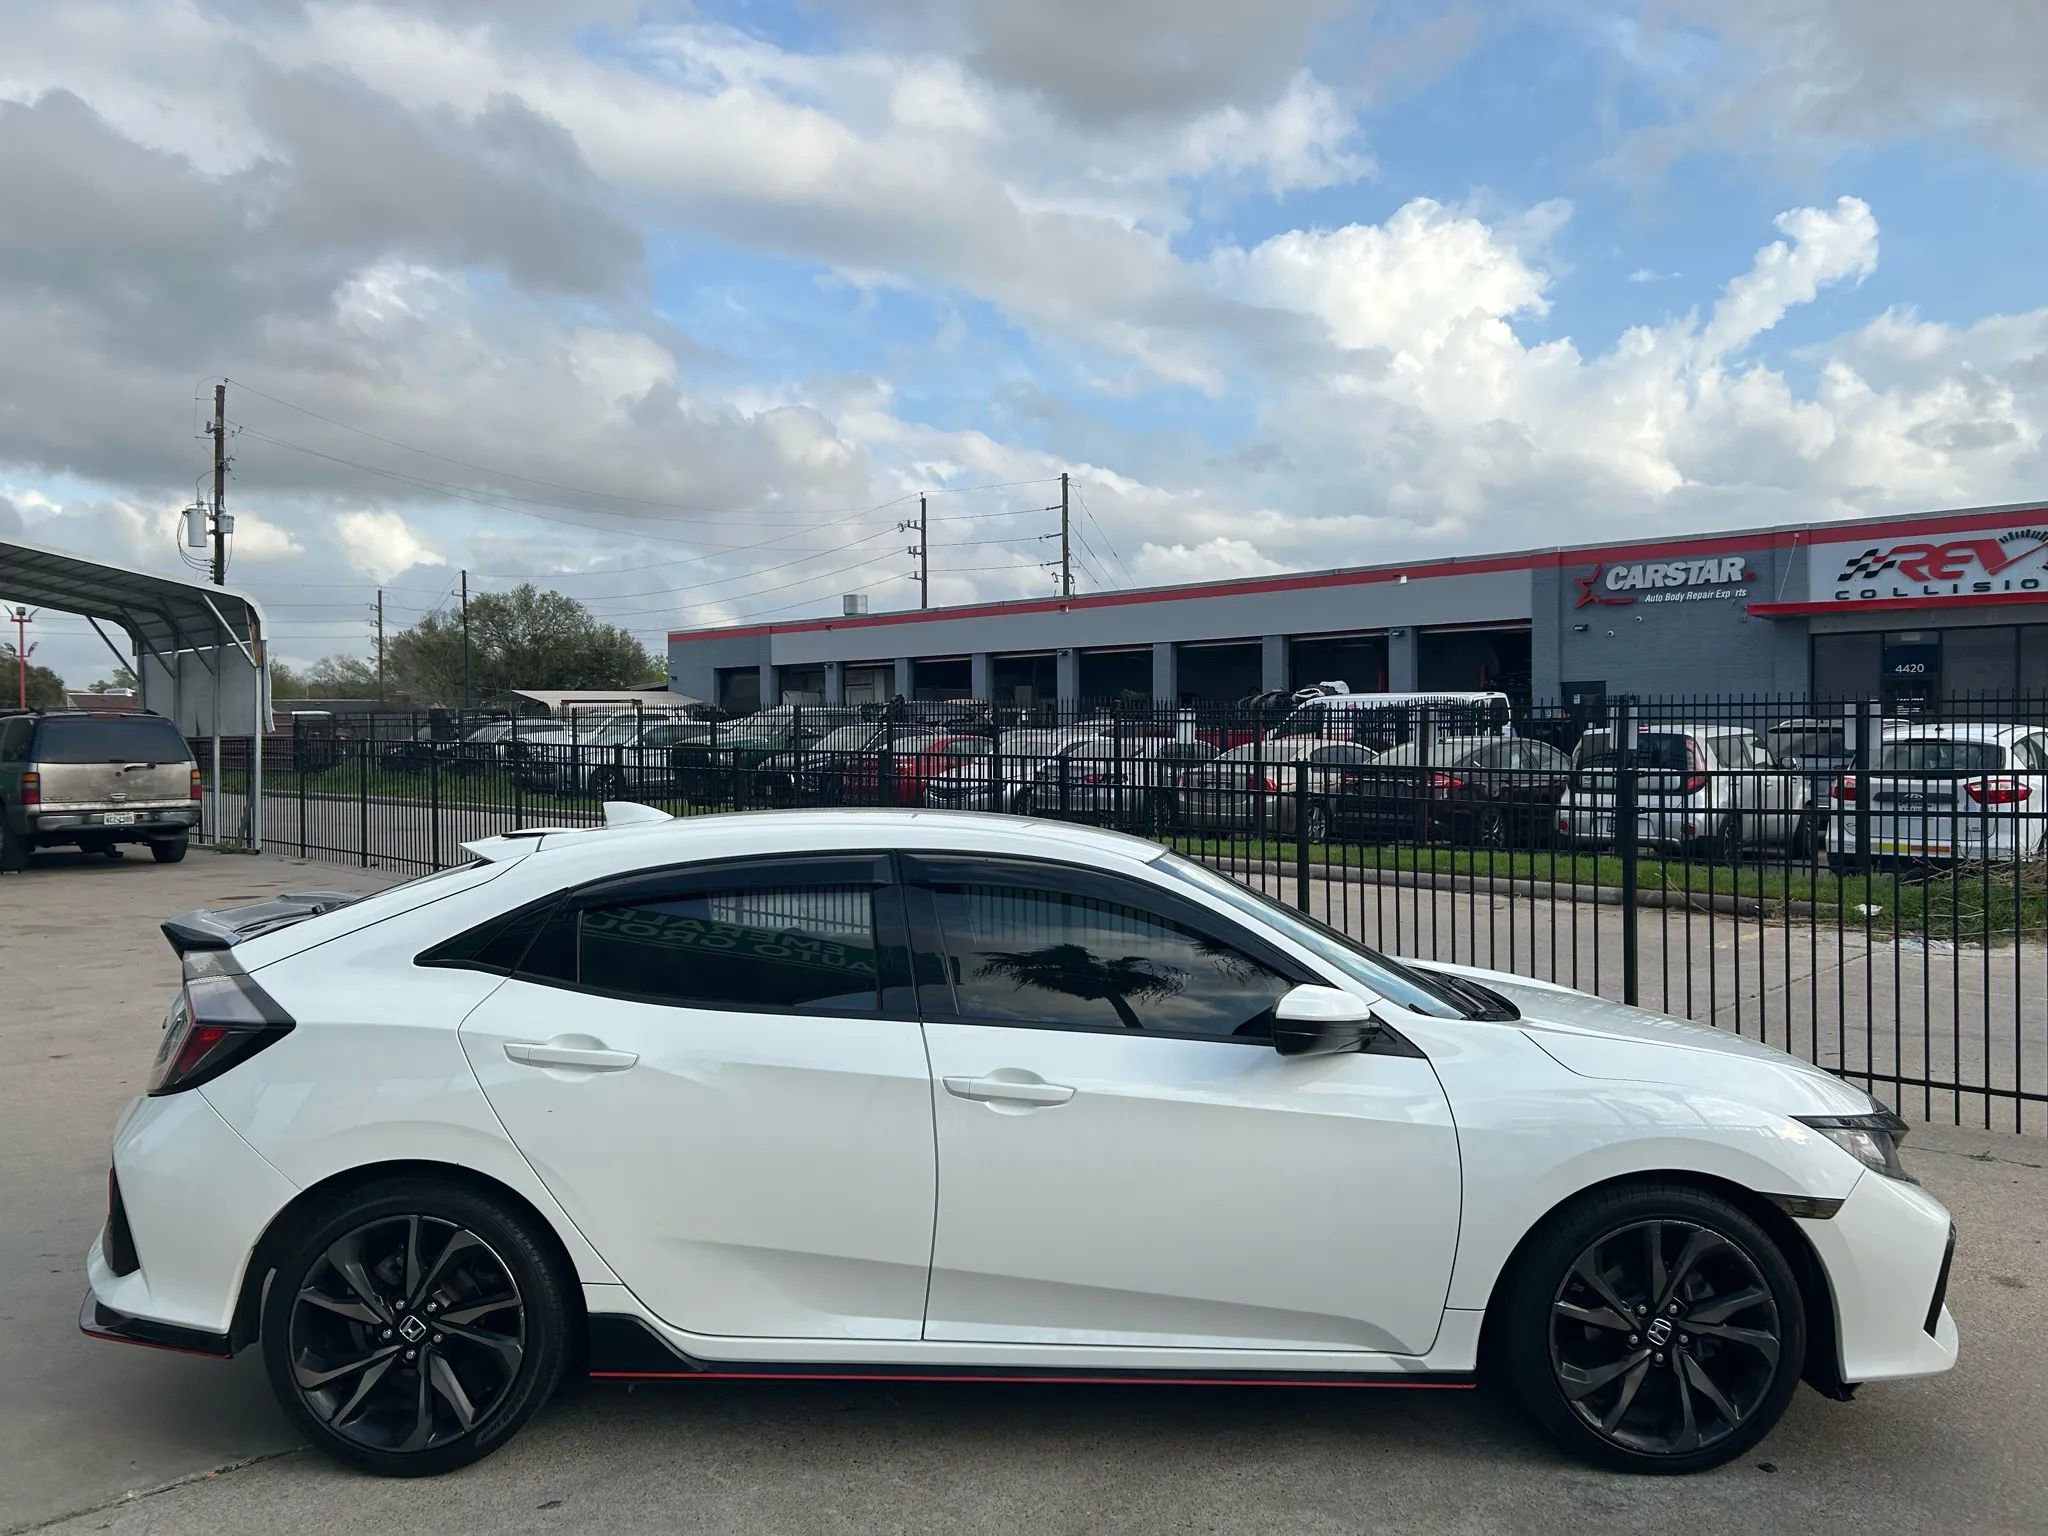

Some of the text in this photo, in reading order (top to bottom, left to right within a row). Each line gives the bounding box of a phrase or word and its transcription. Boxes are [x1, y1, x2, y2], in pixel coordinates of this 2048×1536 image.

[1873, 538, 2048, 582] REV
[1605, 557, 1746, 591] CARSTAR
[1645, 588, 1747, 603] Auto Body Repair Exprts
[1895, 663, 1925, 673] 4420
